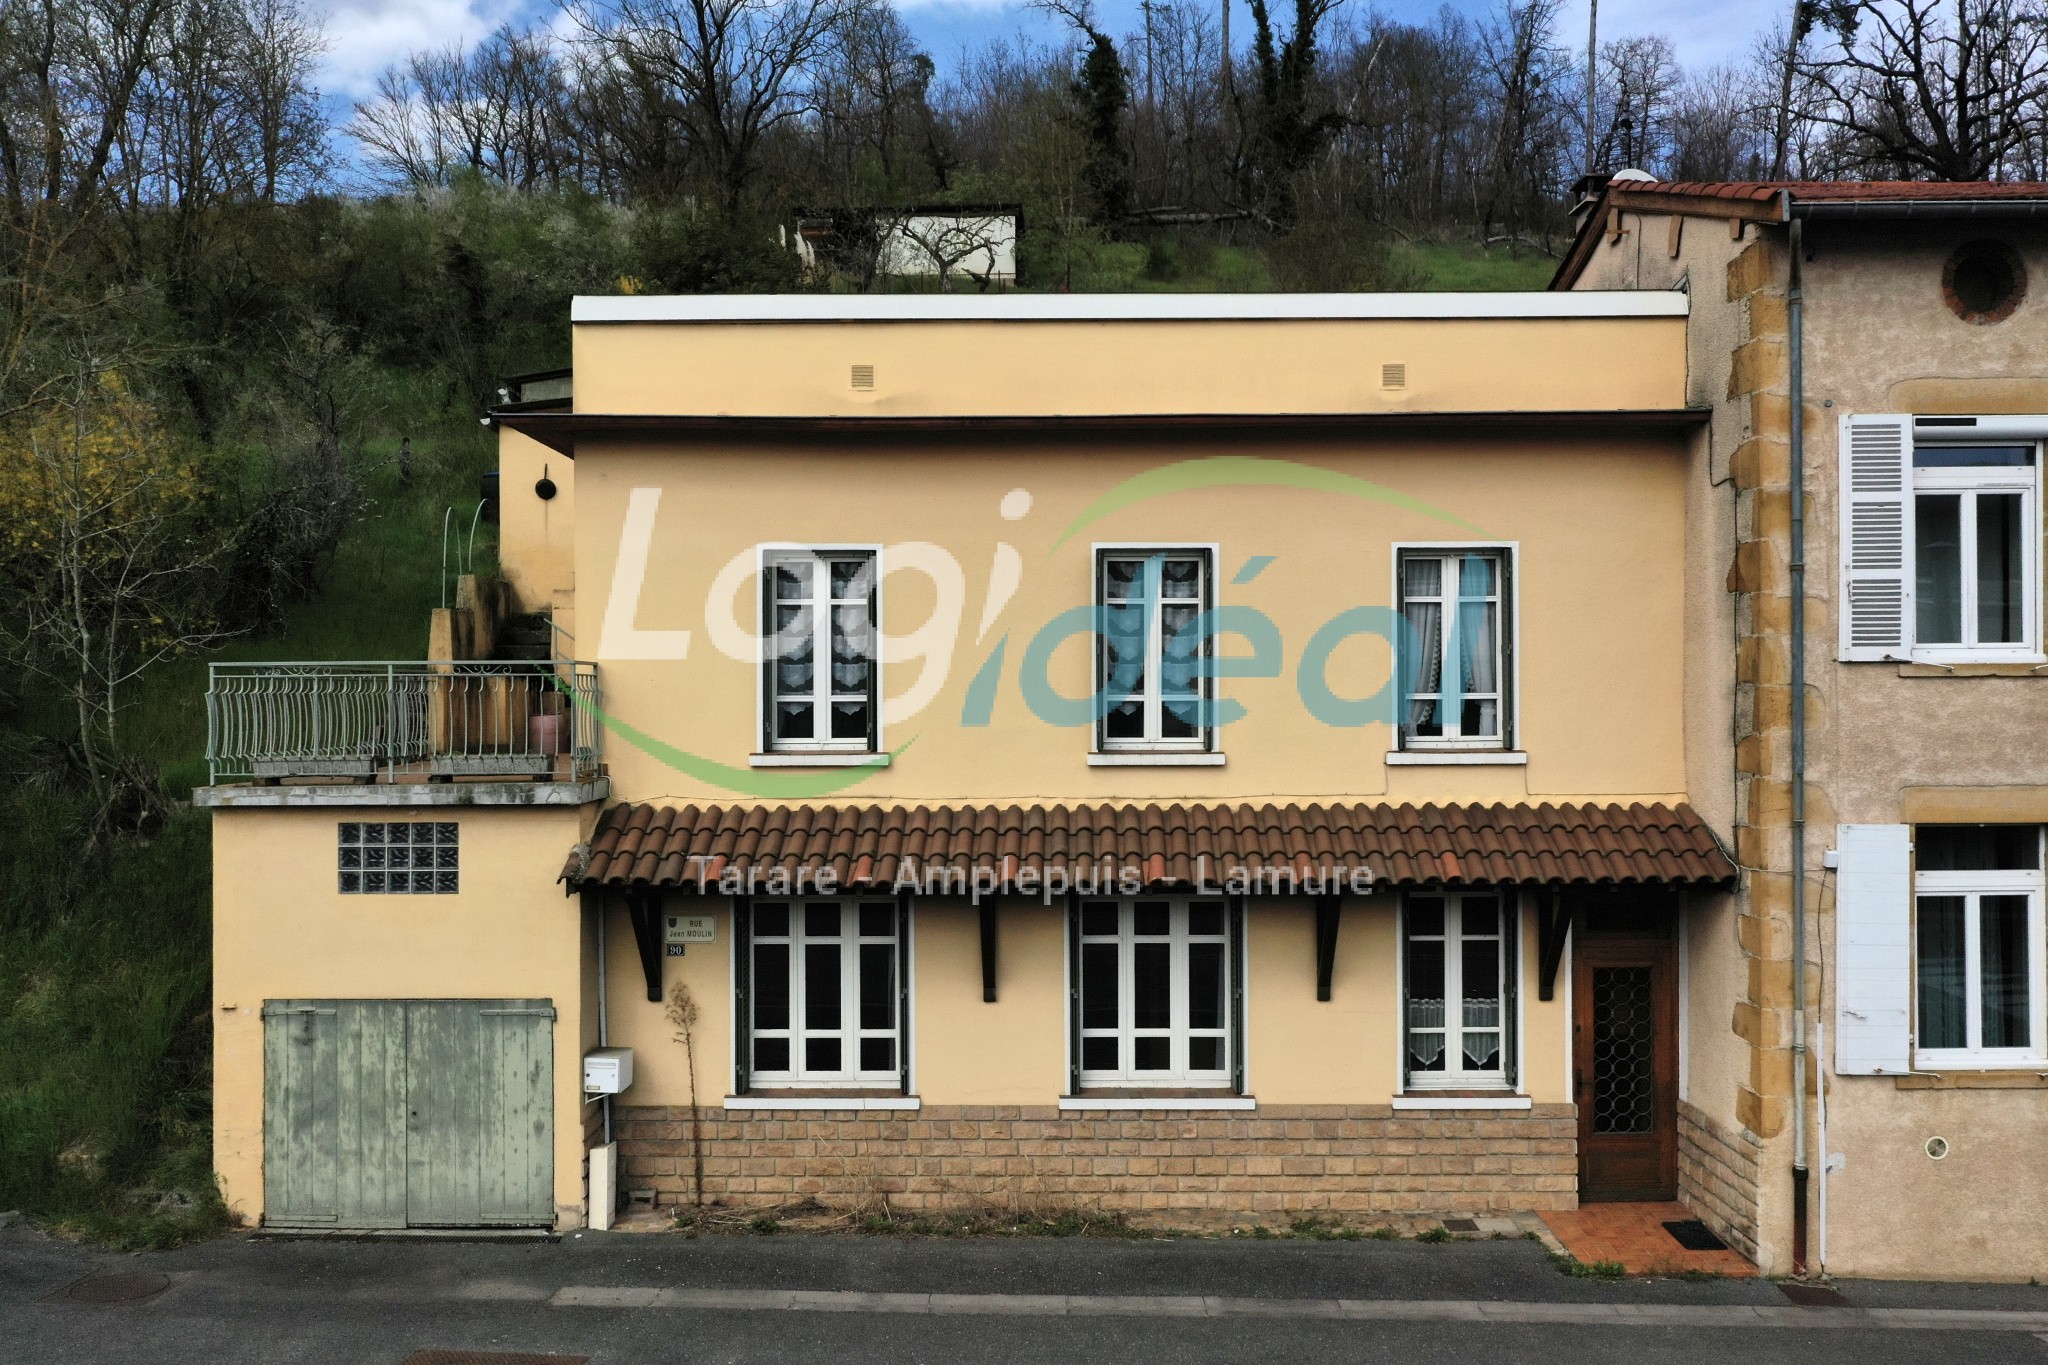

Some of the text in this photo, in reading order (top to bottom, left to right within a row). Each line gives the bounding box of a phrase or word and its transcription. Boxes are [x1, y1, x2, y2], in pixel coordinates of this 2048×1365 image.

[669, 930, 712, 938] Jean MOULIN
[669, 945, 682, 955] 90
